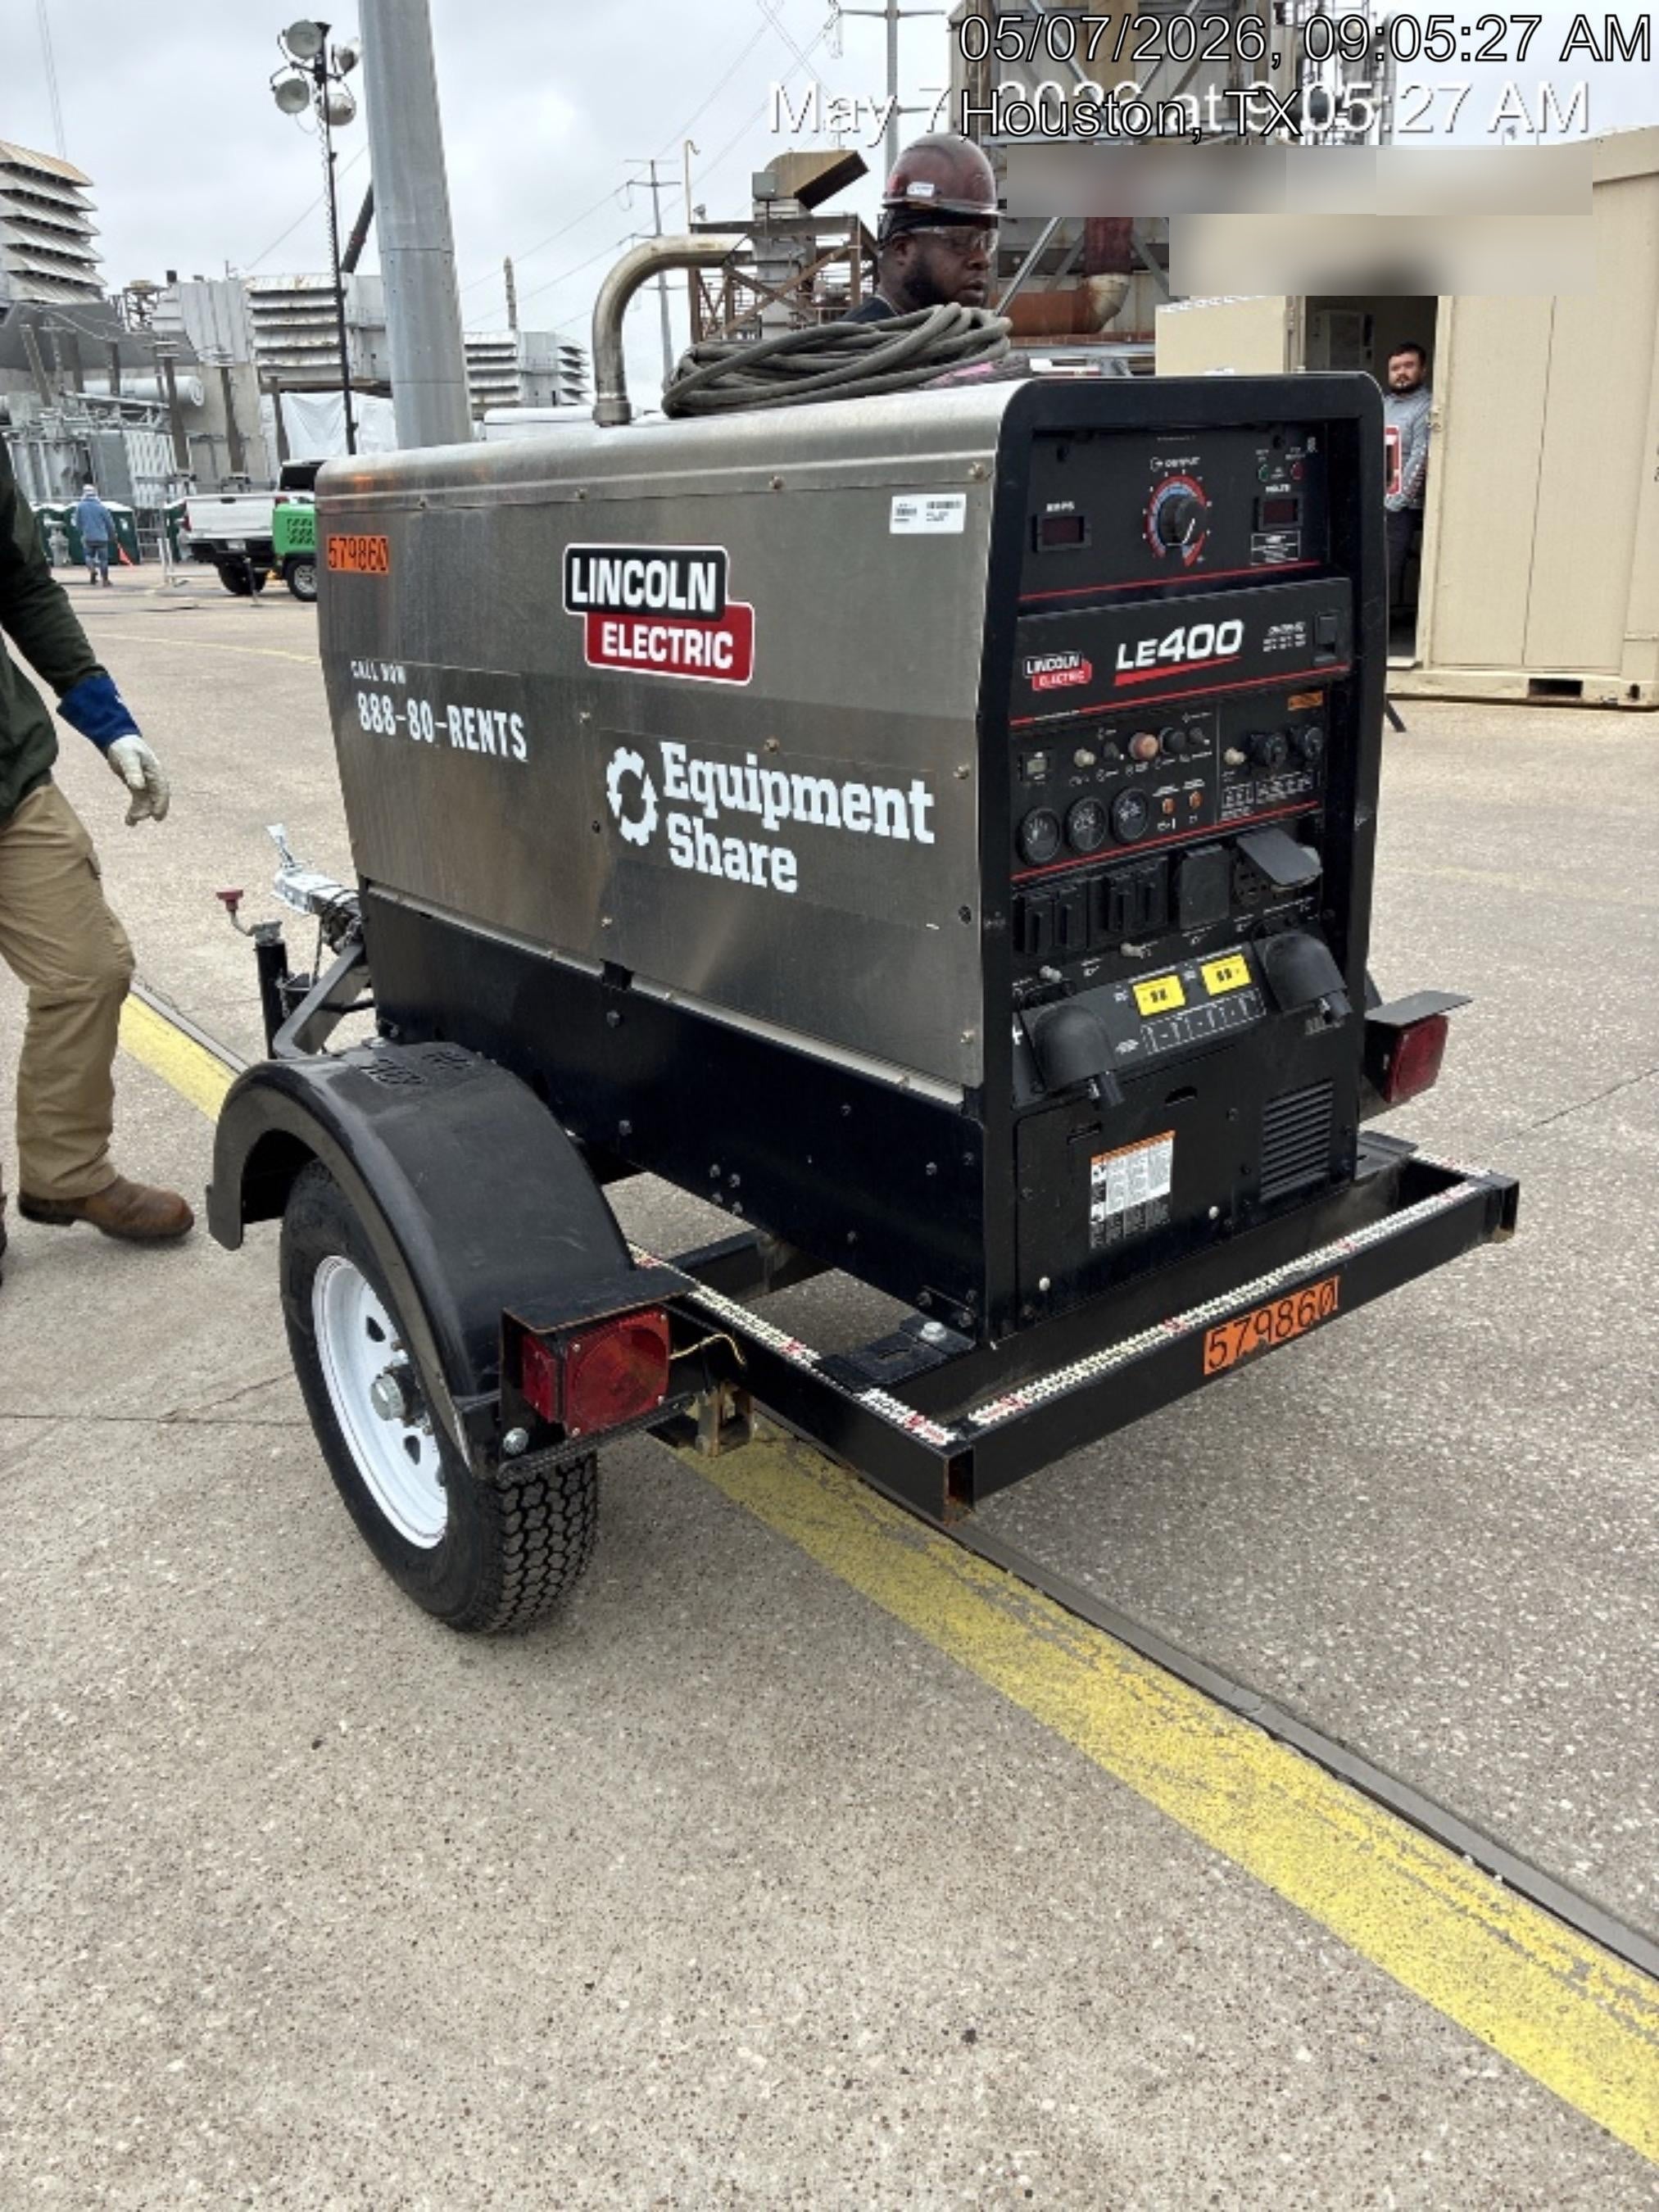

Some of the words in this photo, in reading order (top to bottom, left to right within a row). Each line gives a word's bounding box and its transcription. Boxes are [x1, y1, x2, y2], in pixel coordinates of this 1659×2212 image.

[329, 537, 388, 571] 579860
[573, 558, 717, 612] LINCOLN
[602, 621, 734, 669] ELECTRIC
[1116, 619, 1244, 669] LE400
[358, 691, 528, 759] 888-80-RENTS
[660, 741, 936, 845] Equipment
[666, 812, 799, 893] Share
[1208, 1282, 1335, 1368] 579860
